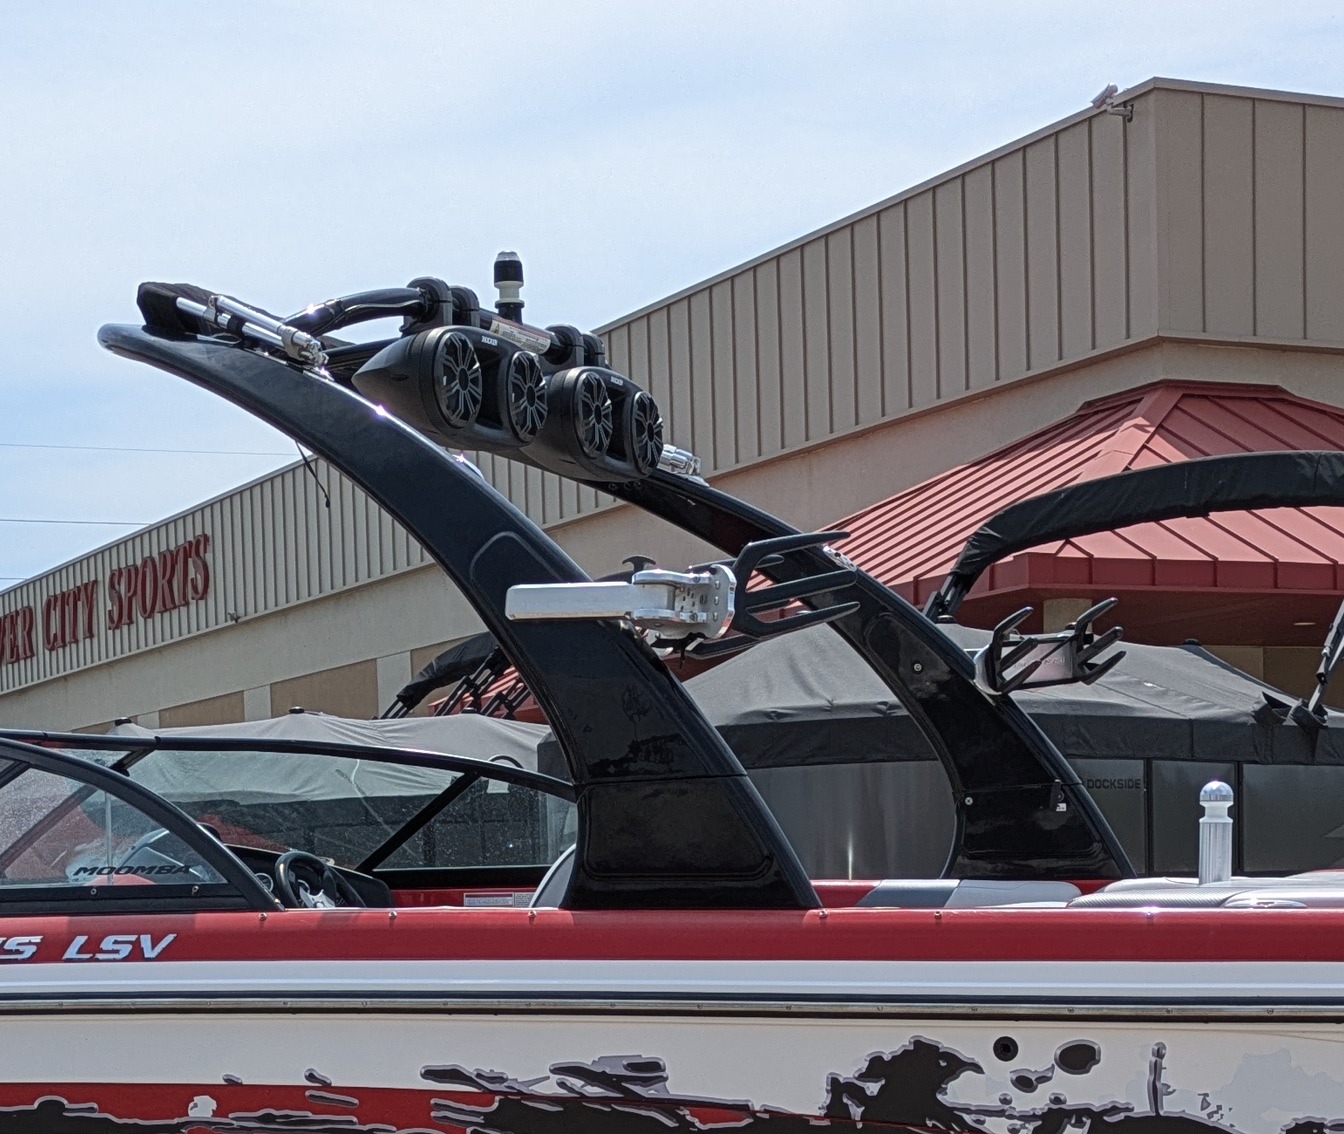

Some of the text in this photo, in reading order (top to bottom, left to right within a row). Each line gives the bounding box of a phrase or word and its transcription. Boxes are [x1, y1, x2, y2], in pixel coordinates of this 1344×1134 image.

[42, 579, 98, 652] CITY
[108, 533, 210, 631] SPORTS
[1086, 778, 1141, 790] DOCKSIDE
[73, 865, 191, 876] MOOMBA
[63, 933, 178, 961] LSV
